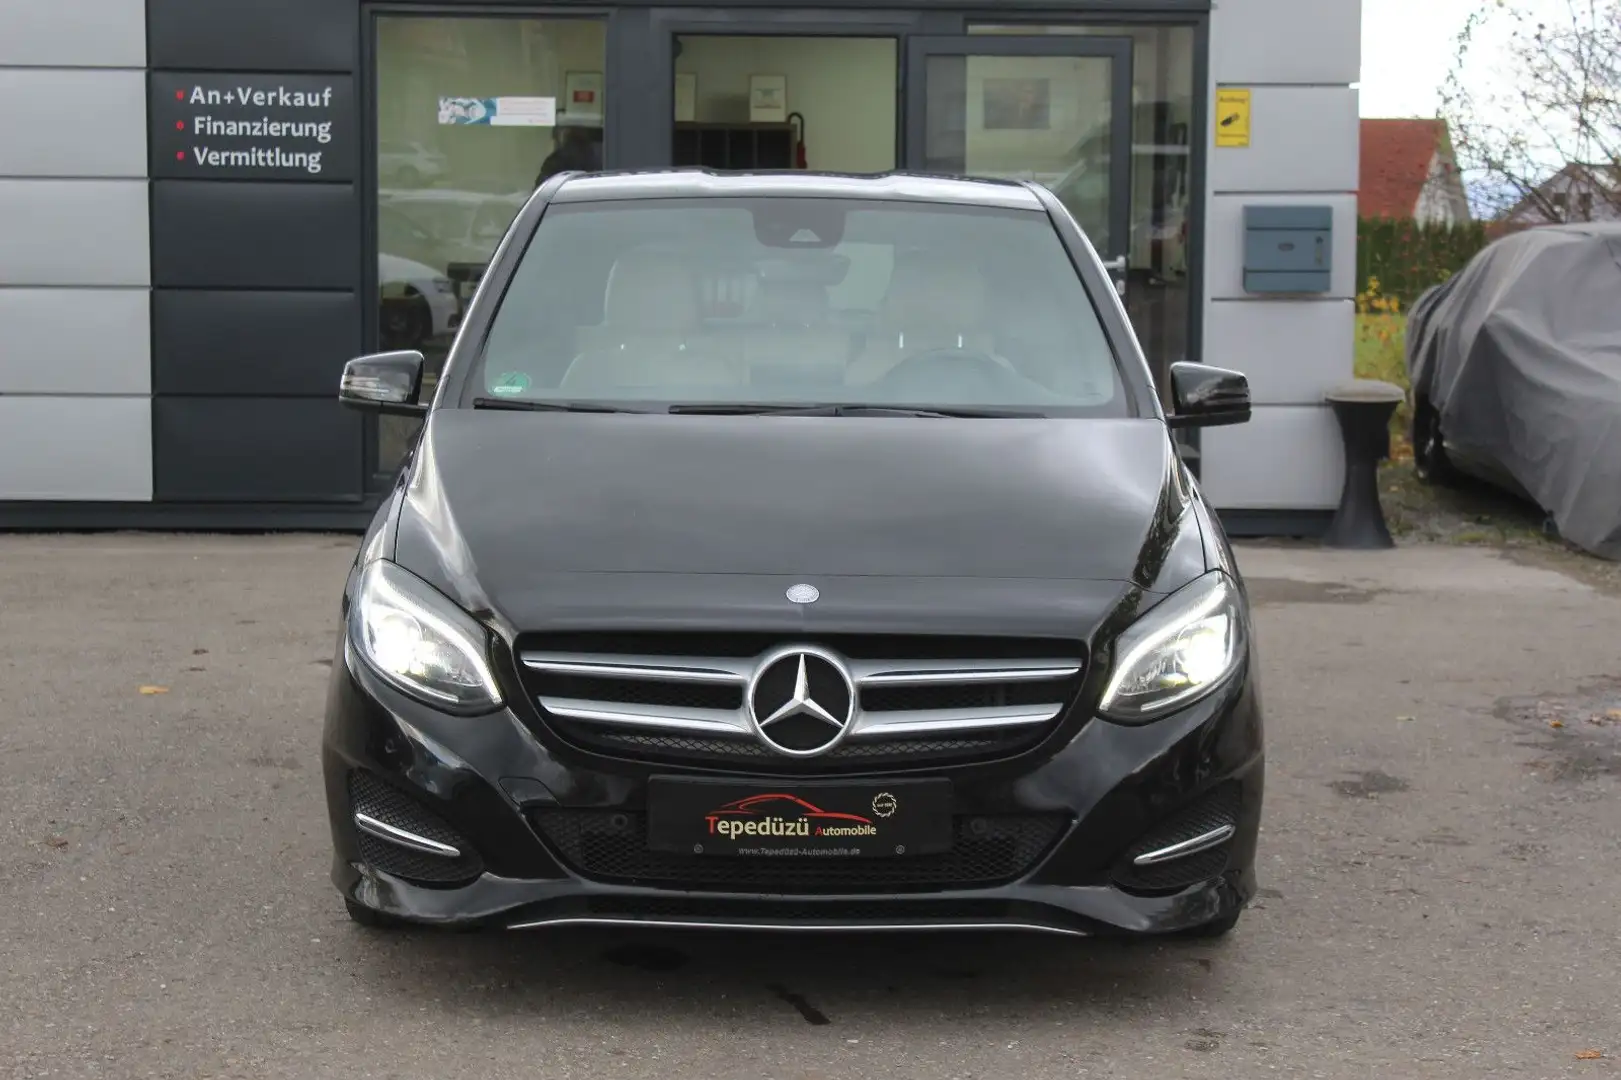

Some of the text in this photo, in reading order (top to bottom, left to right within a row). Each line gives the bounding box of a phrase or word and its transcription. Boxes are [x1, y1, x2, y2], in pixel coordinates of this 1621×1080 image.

[189, 86, 332, 107] An+Verkauf
[194, 116, 332, 143] Finanzierung
[194, 146, 322, 173] Vermittlung
[705, 816, 877, 840] Tepedüzü Automobile
